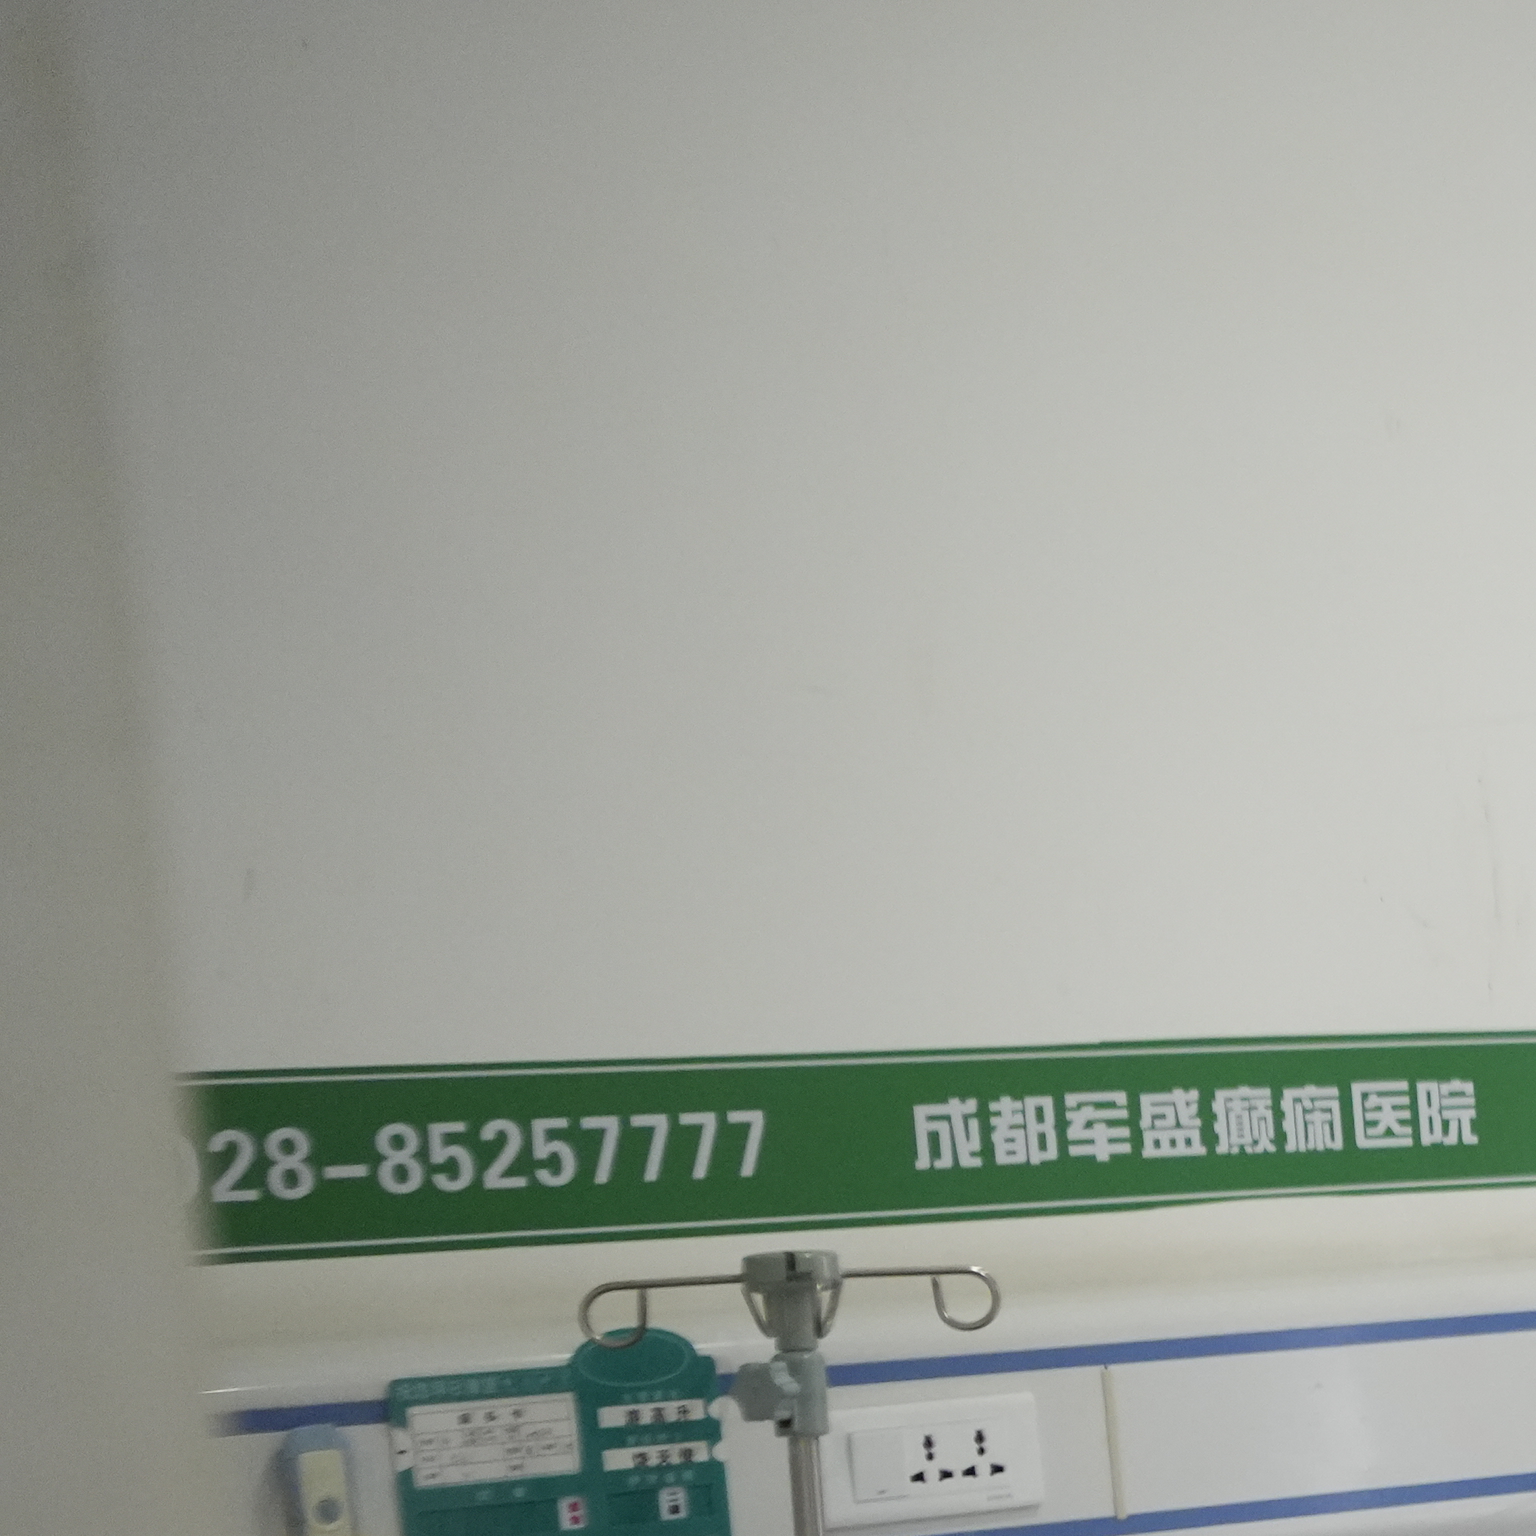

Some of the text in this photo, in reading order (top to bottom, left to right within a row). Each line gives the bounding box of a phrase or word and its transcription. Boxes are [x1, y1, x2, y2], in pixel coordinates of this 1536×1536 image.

[187, 1109, 767, 1203] 28-85257777
[912, 1078, 1479, 1171] 成都军盛癫痫医院
